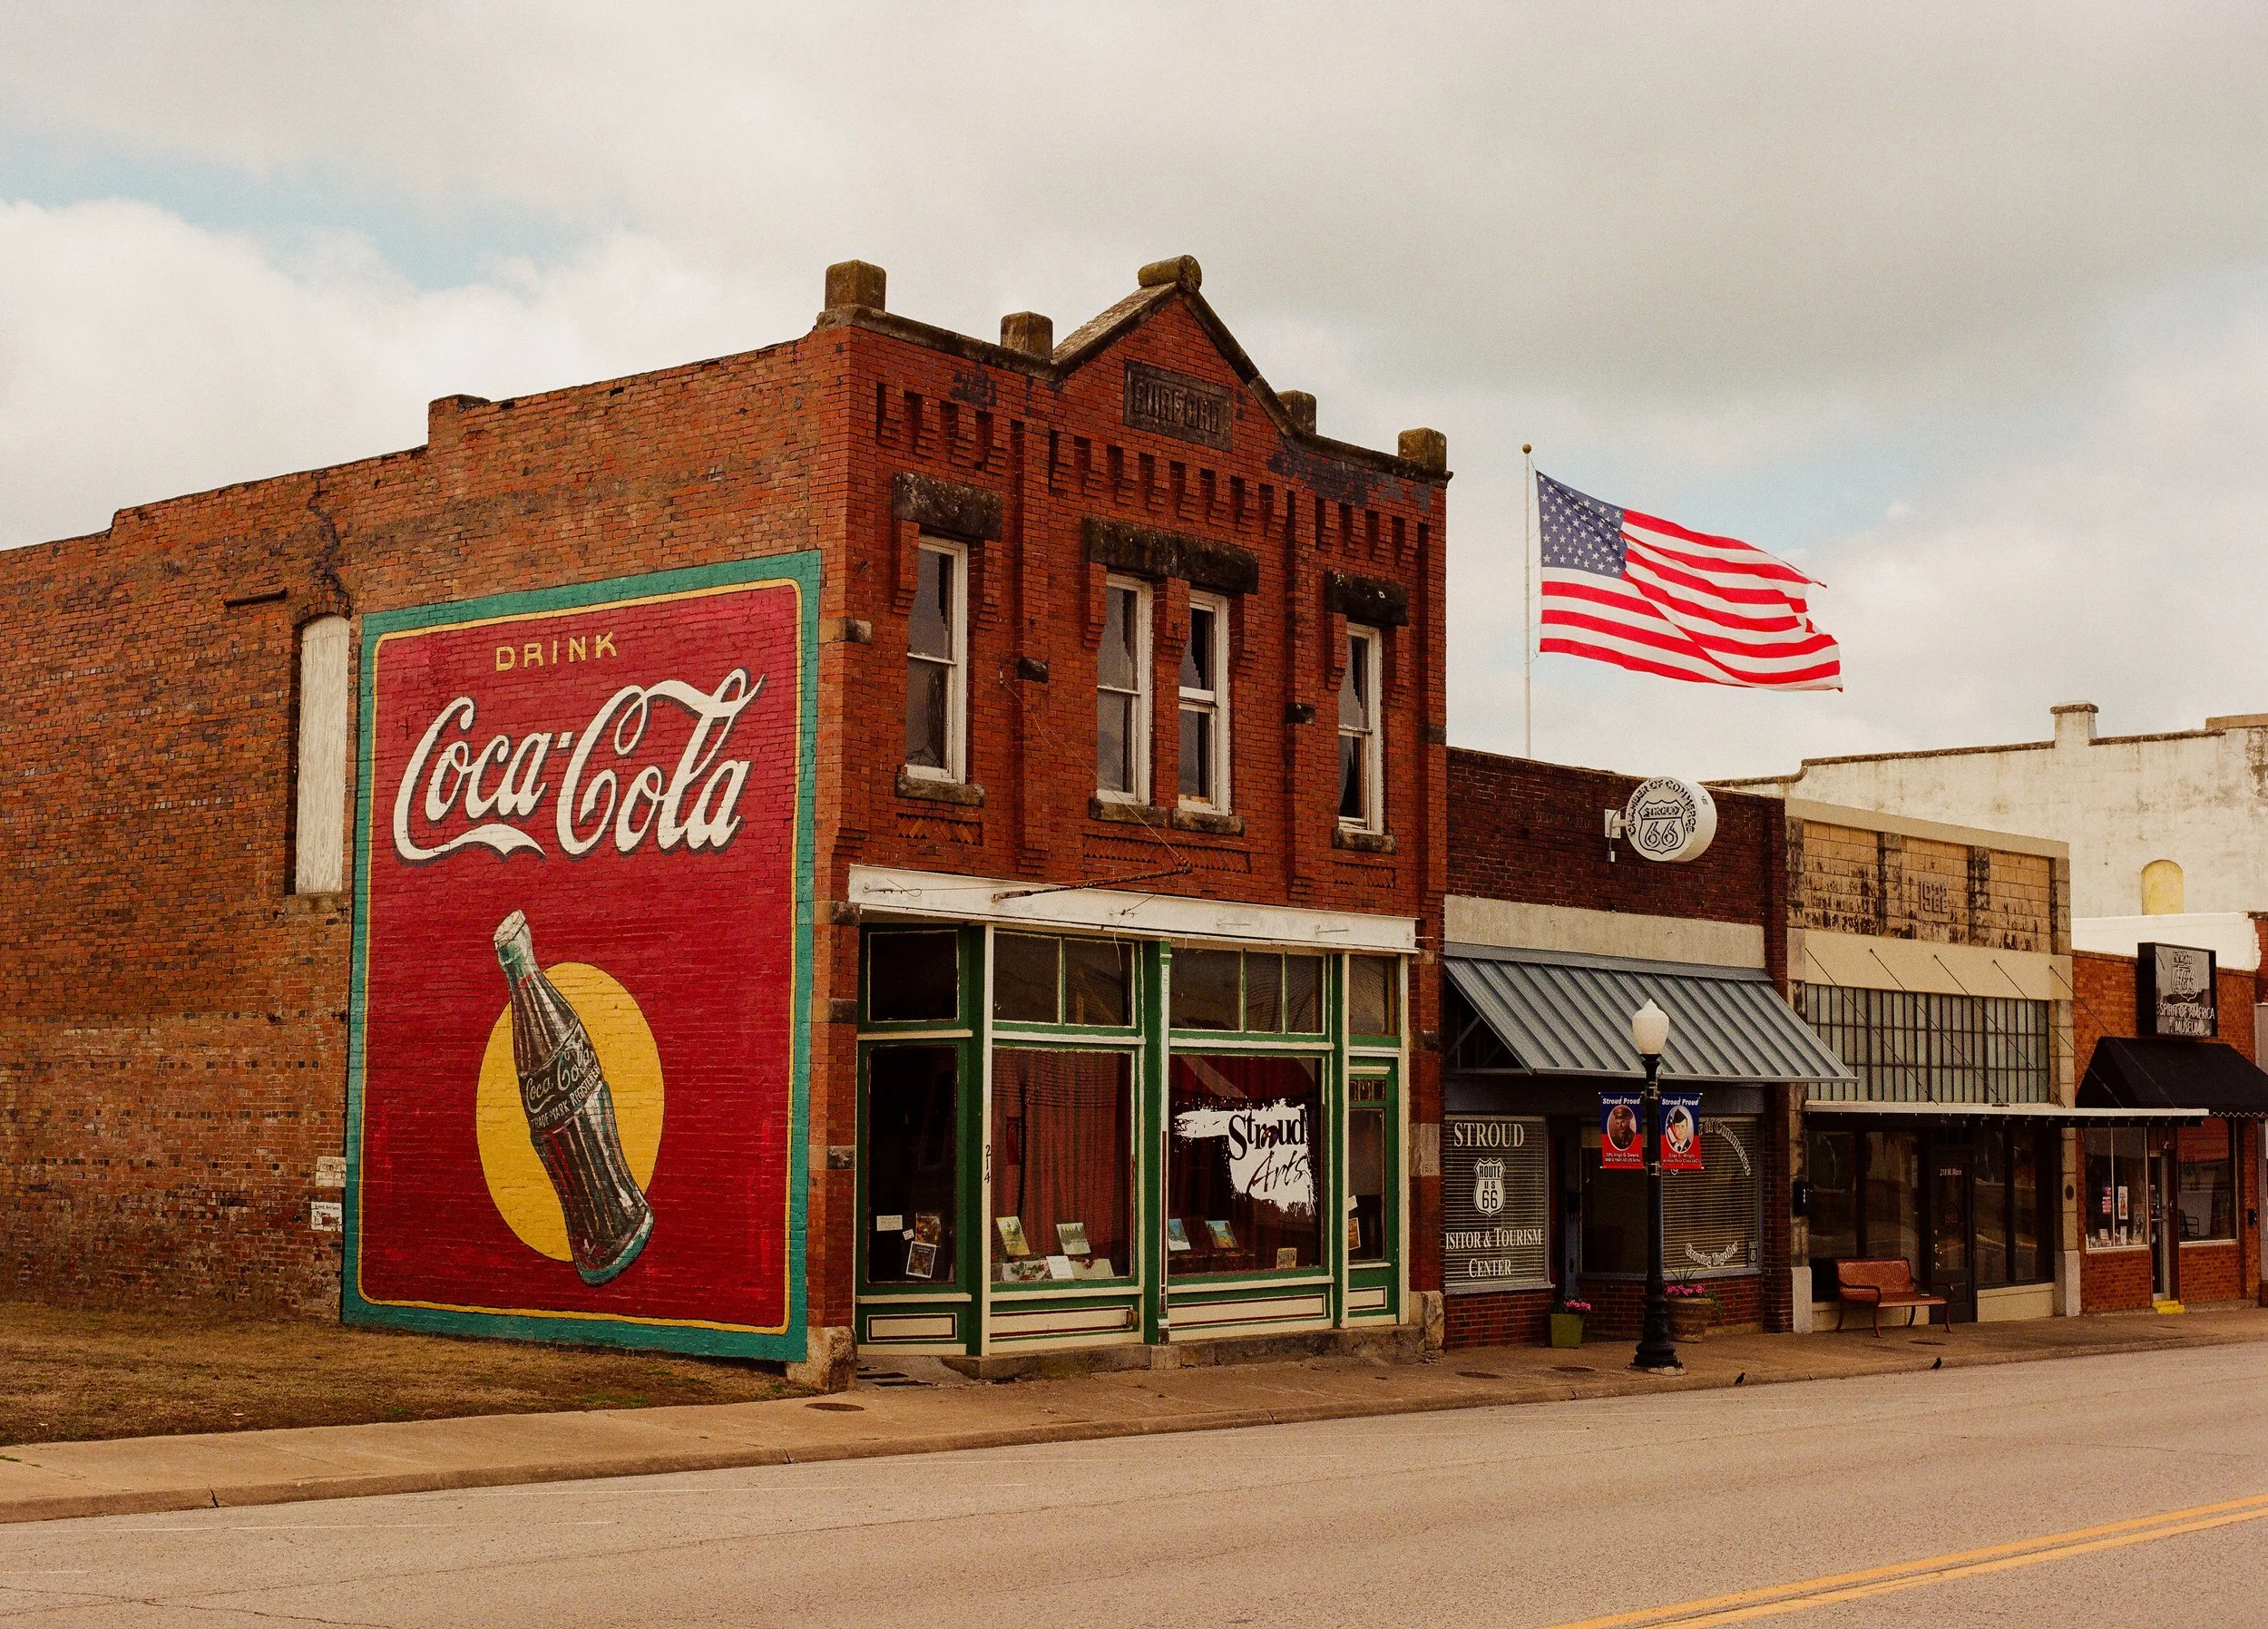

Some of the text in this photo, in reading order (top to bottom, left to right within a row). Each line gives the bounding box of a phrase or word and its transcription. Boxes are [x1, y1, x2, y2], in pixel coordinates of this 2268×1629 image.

[495, 631, 618, 673] DRINK
[393, 668, 766, 860] Coca-Cola
[1649, 779, 1664, 791] OF
[1644, 820, 1679, 849] 66
[2188, 1006, 2215, 1020] AMERICA
[1662, 1098, 1680, 1107] Stroud
[1228, 1108, 1305, 1161] Stroud
[1453, 1122, 1524, 1147] STROUD
[1246, 1149, 1309, 1194] Arts
[1479, 1165, 1501, 1178] ROUTE
[1481, 1190, 1498, 1209] 66
[1483, 1230, 1491, 1248] &
